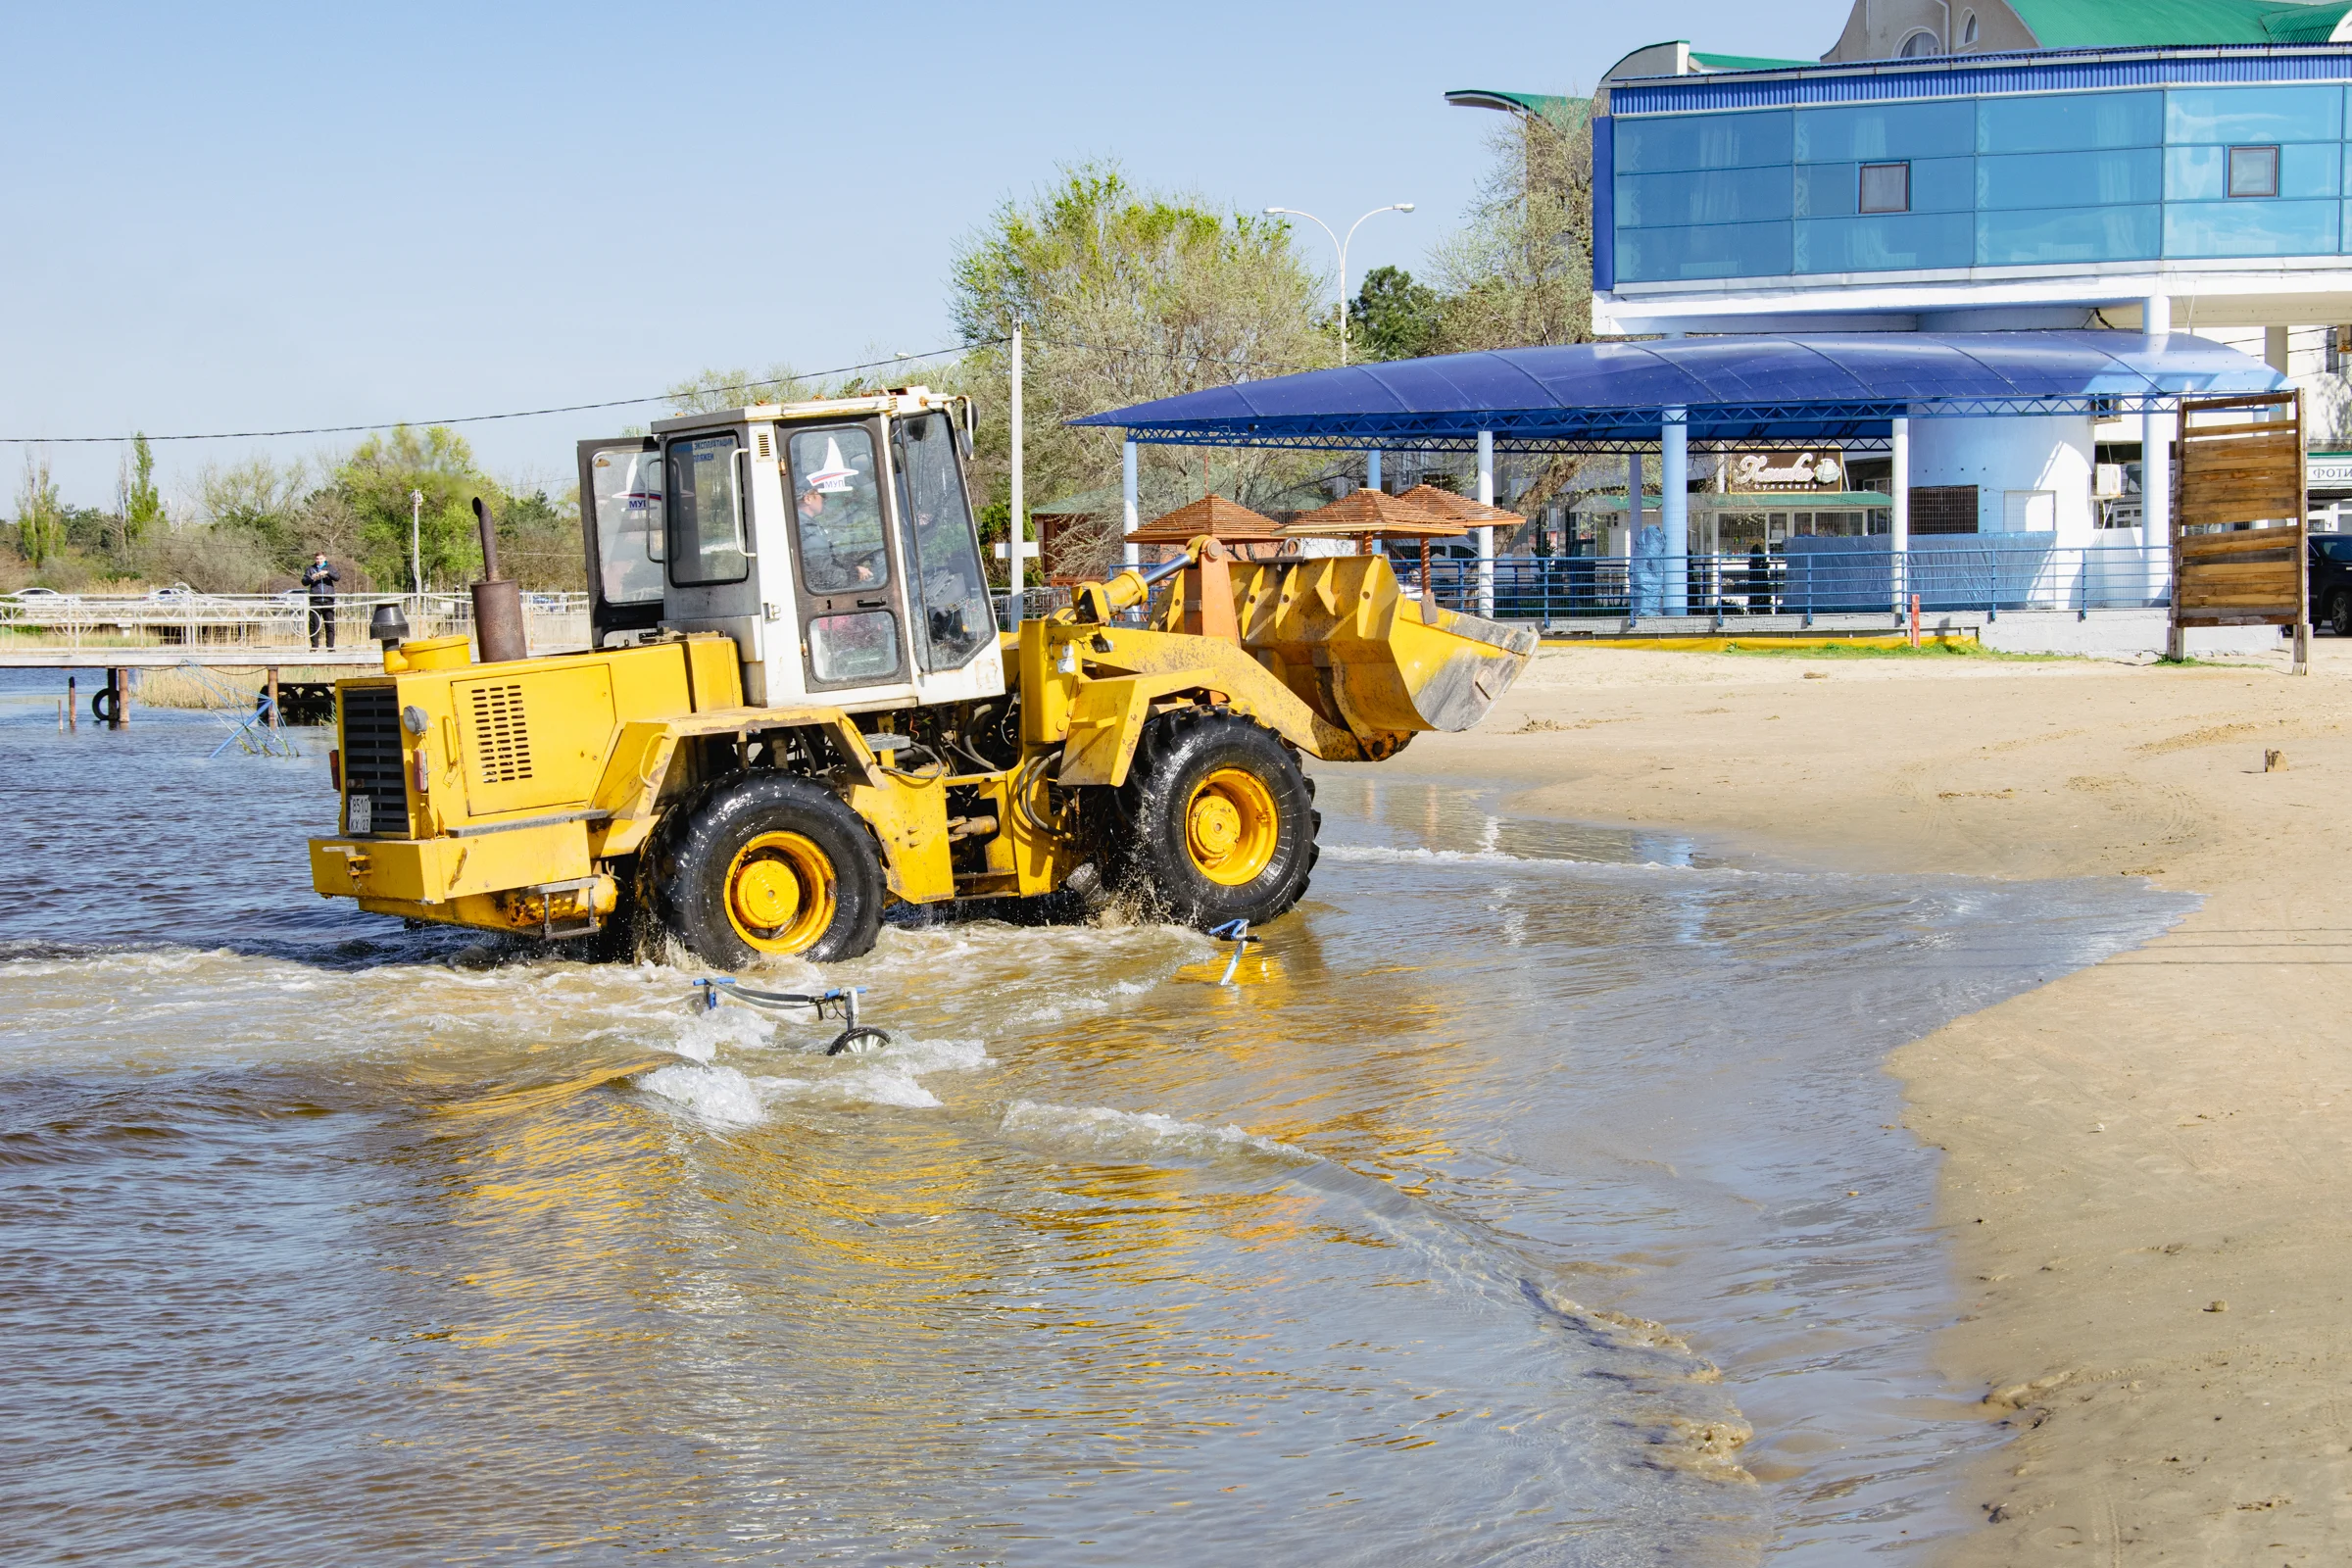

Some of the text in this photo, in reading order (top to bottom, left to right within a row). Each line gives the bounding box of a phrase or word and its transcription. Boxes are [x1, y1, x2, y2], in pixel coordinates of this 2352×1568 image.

[694, 438, 734, 451] ЭКСПЛУАТАЦИИ
[825, 479, 844, 489] МУП
[353, 798, 368, 812] 8510
[362, 818, 368, 831] 23
